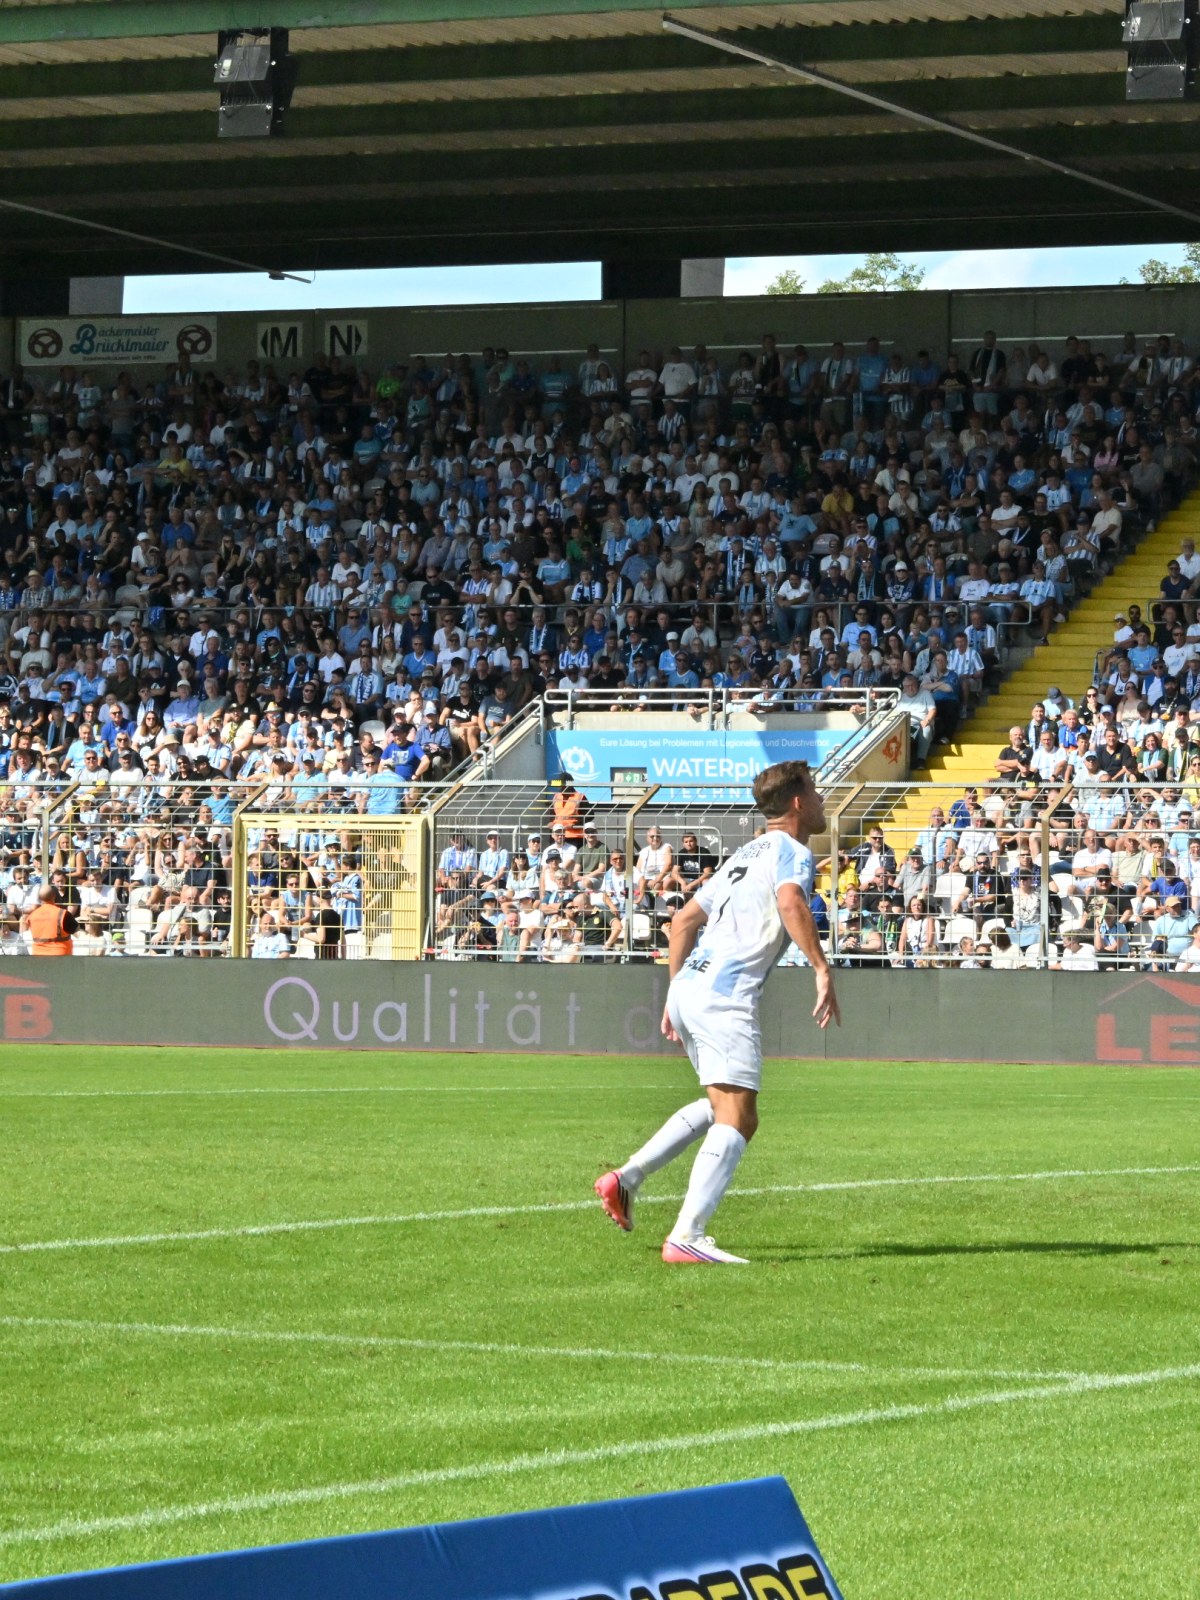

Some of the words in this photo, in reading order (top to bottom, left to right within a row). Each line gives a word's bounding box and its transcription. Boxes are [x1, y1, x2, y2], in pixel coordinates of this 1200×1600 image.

[69, 324, 170, 354] Brücklmaier
[271, 326, 298, 358] M
[330, 325, 353, 356] N
[600, 738, 618, 747] Eure
[620, 737, 647, 749] Lösung
[649, 738, 661, 747] bei
[662, 738, 705, 747] Problemen
[706, 738, 718, 747] mit
[765, 738, 779, 747] und
[652, 757, 778, 782] WATERplu
[264, 973, 581, 1046] Qualität
